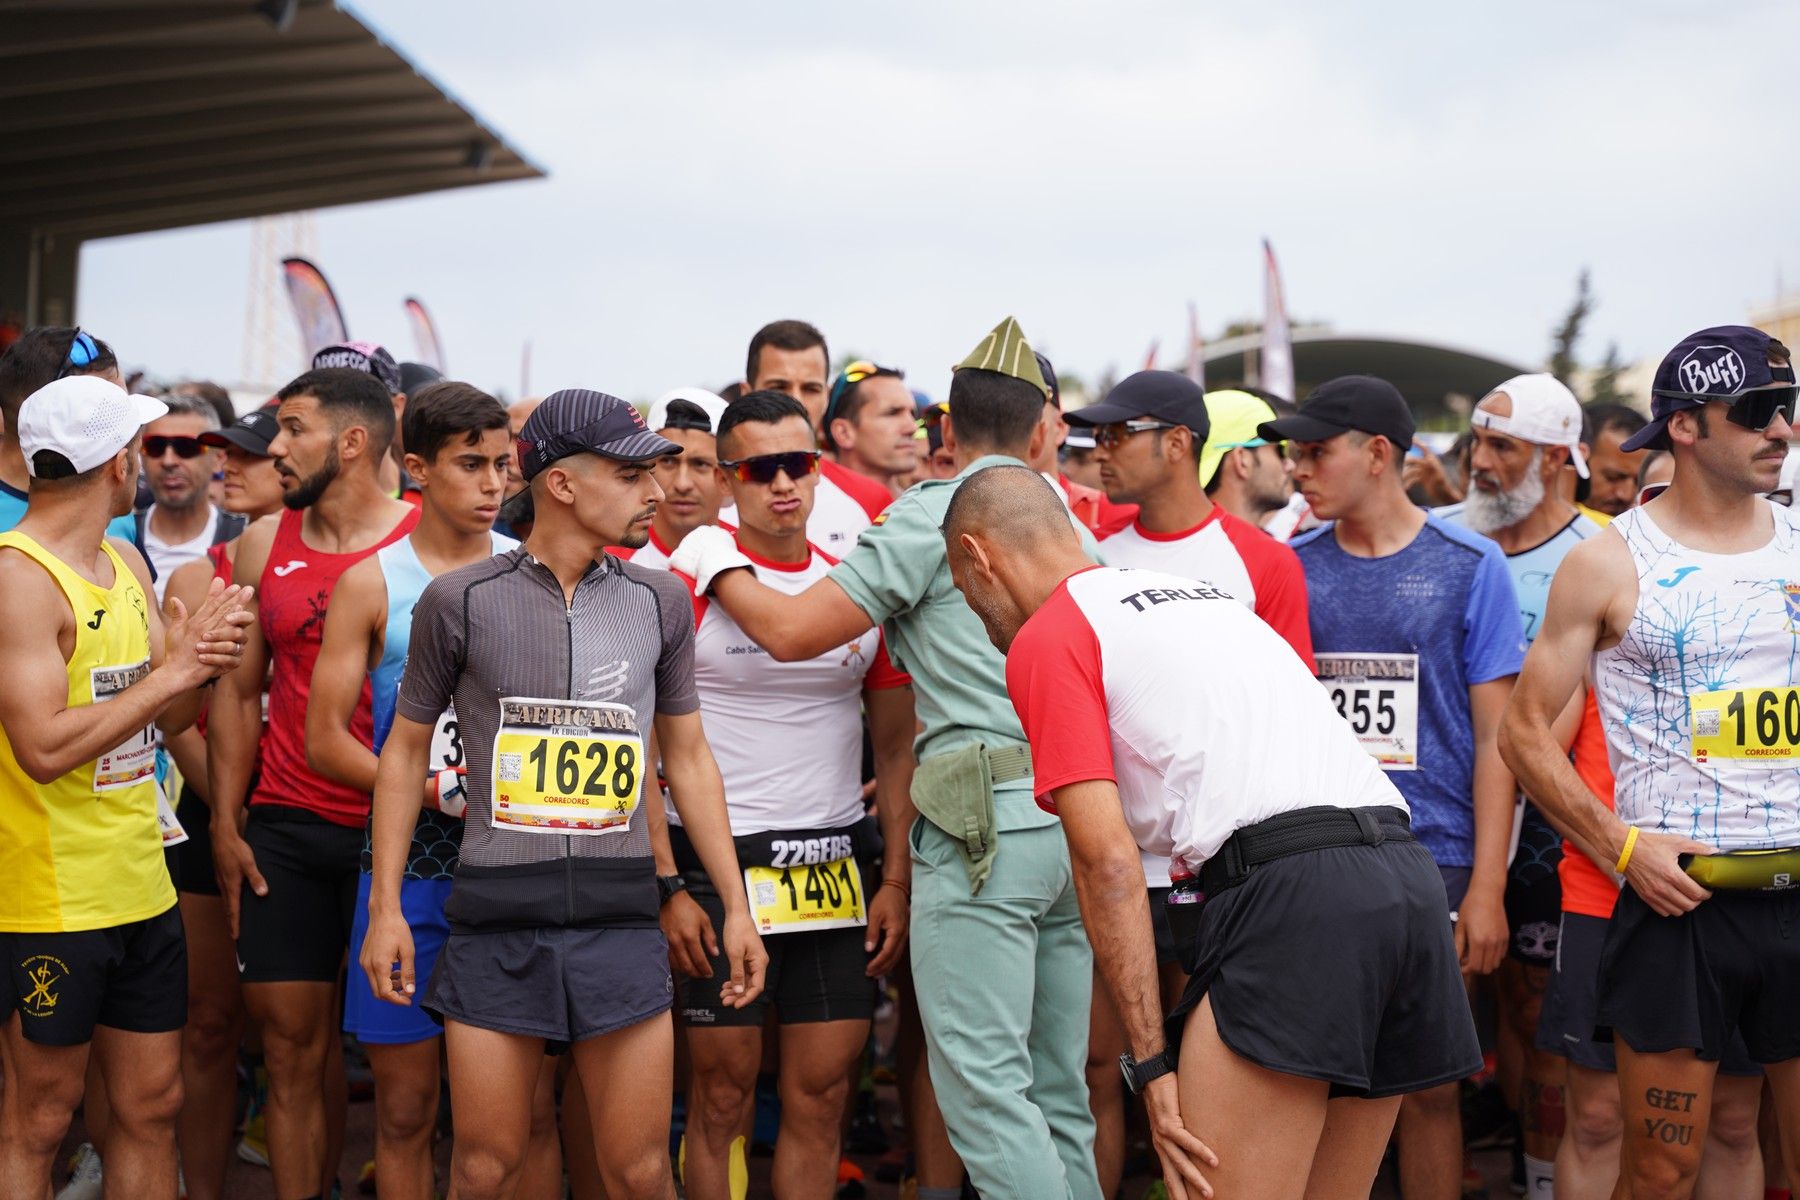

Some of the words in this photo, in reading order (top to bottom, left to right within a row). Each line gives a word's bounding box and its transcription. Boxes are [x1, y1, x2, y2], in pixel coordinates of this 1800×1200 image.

[517, 704, 634, 730] AFRICANA
[1744, 748, 1792, 756] CORREDORES
[529, 738, 636, 799] 1628
[500, 794, 510, 802] 50
[543, 796, 590, 806] CORREDORES
[771, 834, 852, 869] 226ERS
[779, 860, 857, 912] 1401
[1645, 1086, 1698, 1113] GET
[1643, 1117, 1695, 1146] YOU
